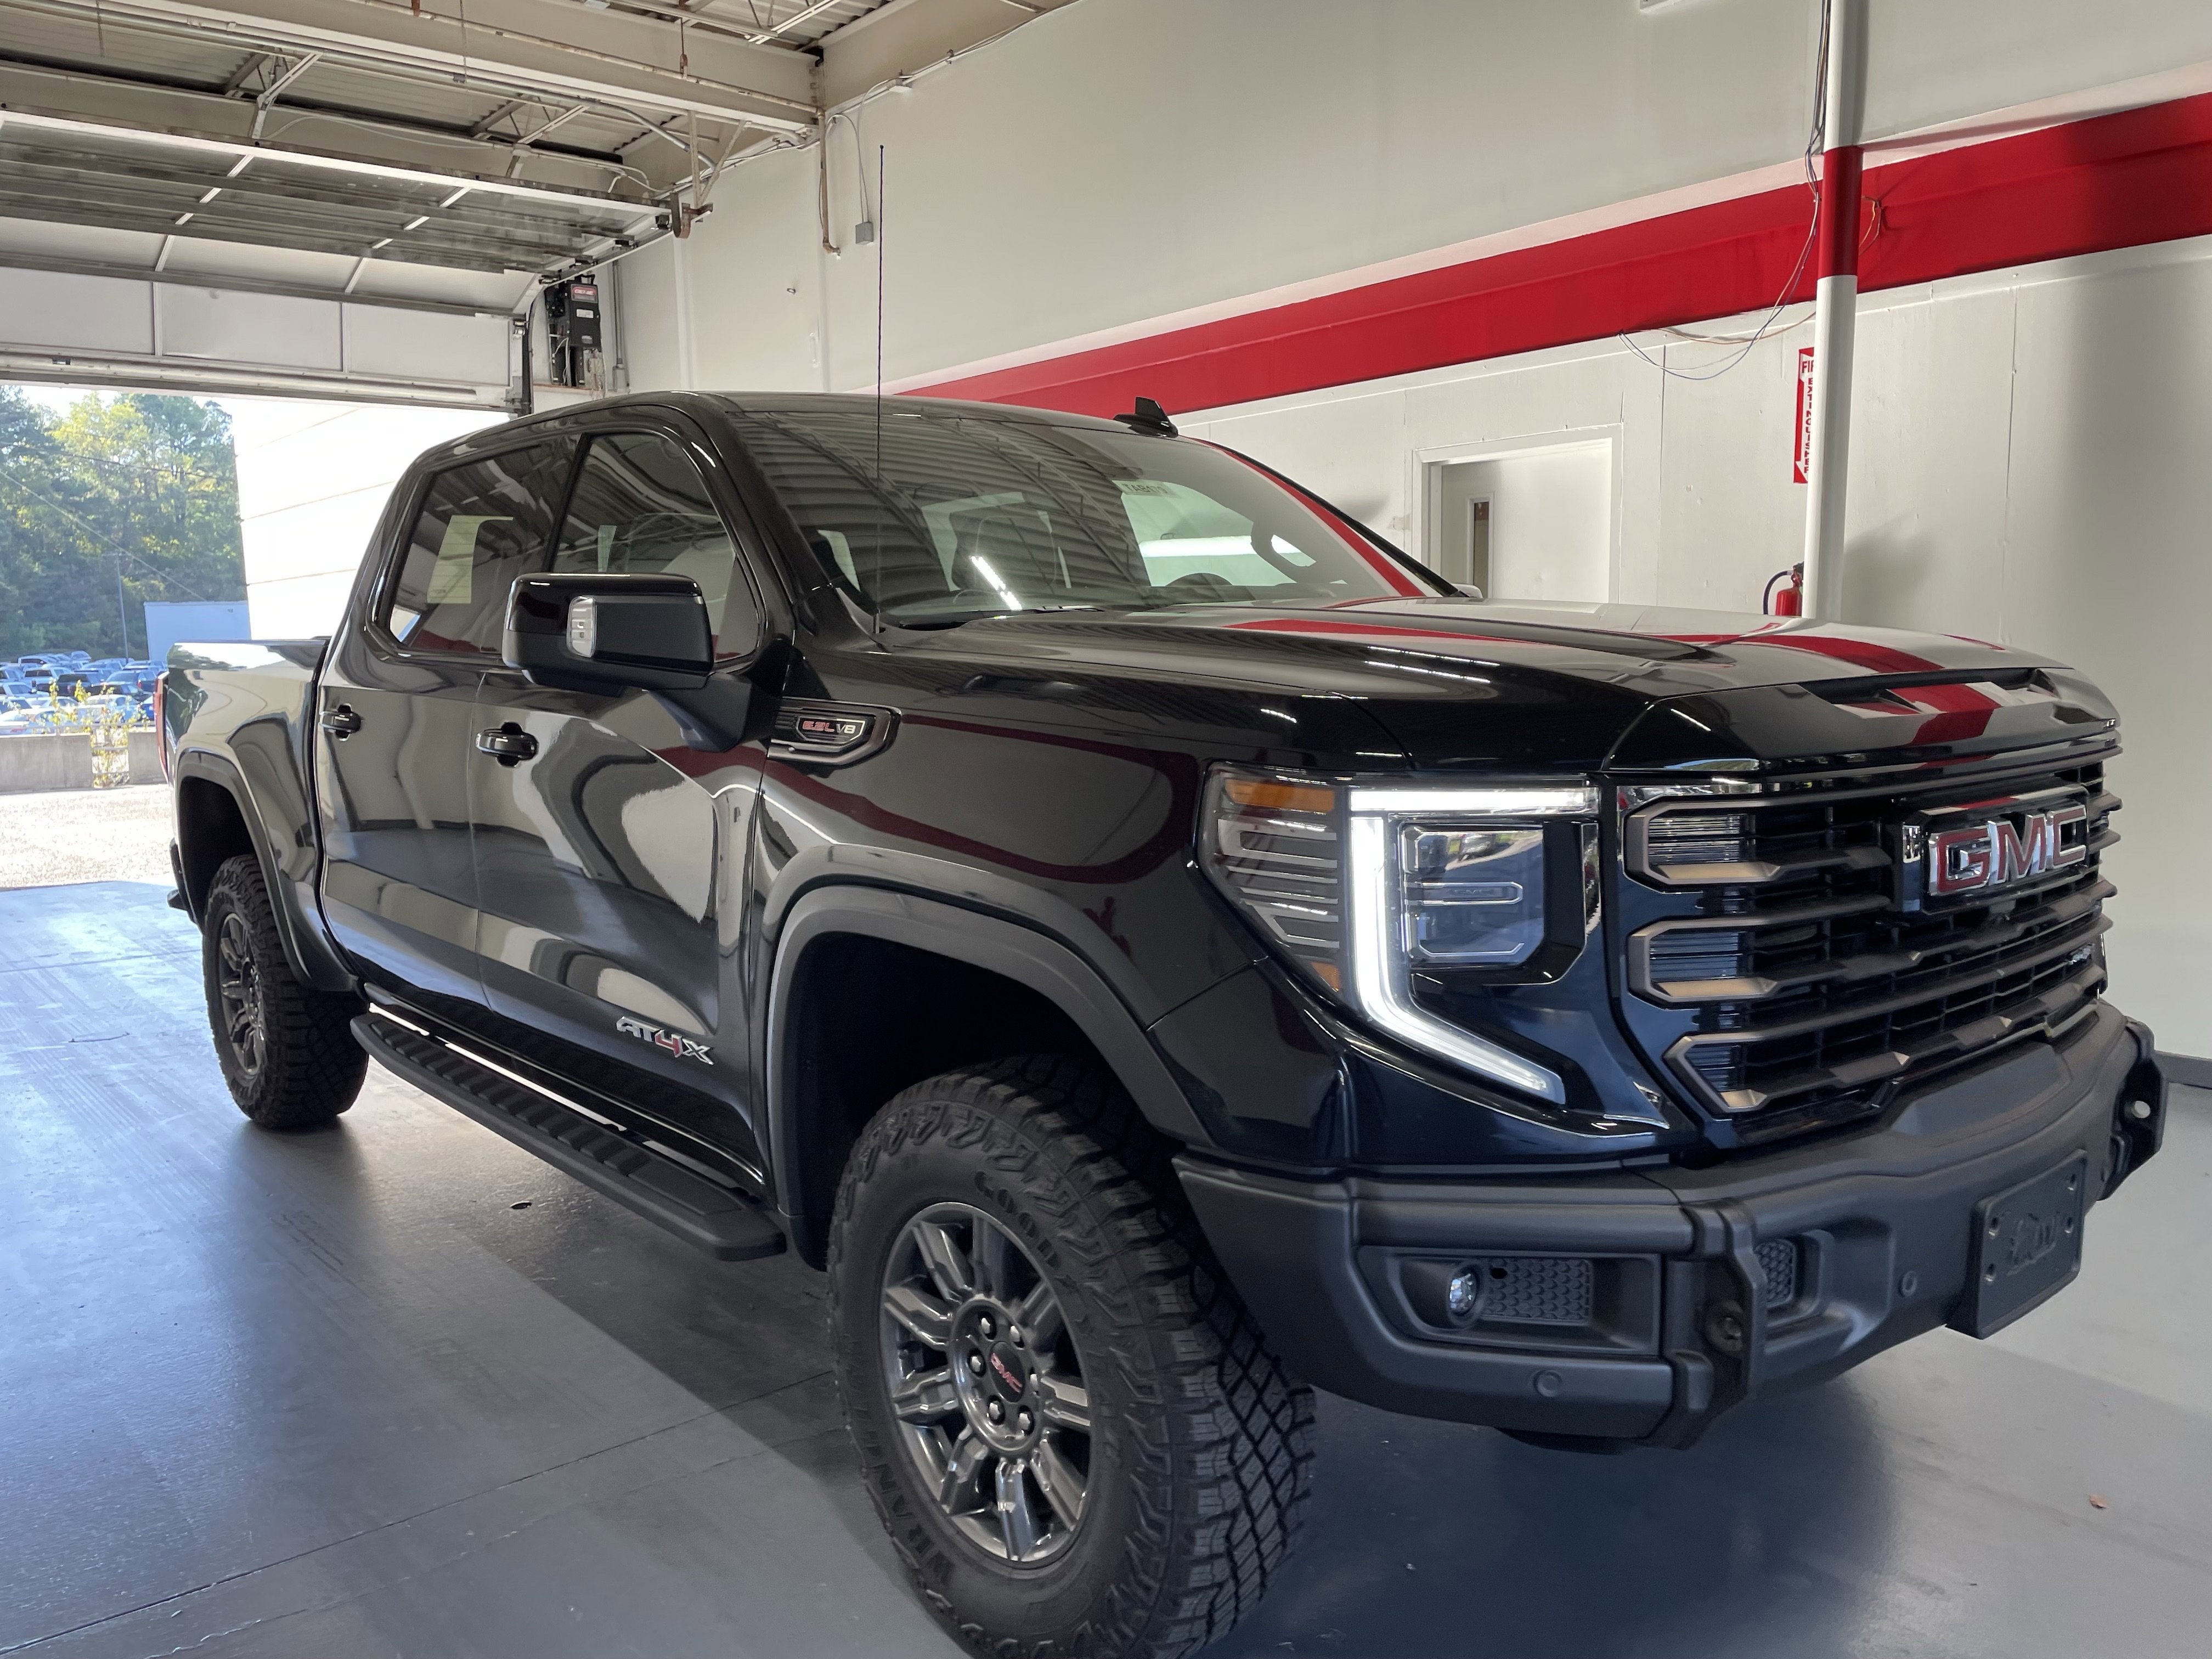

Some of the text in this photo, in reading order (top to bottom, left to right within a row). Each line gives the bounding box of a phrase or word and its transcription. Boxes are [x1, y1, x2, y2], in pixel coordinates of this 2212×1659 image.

[836, 723, 856, 734] V8
[1929, 804, 2086, 896] GMC
[616, 1016, 714, 1065] AT4X
[990, 1352, 1023, 1393] GMC
